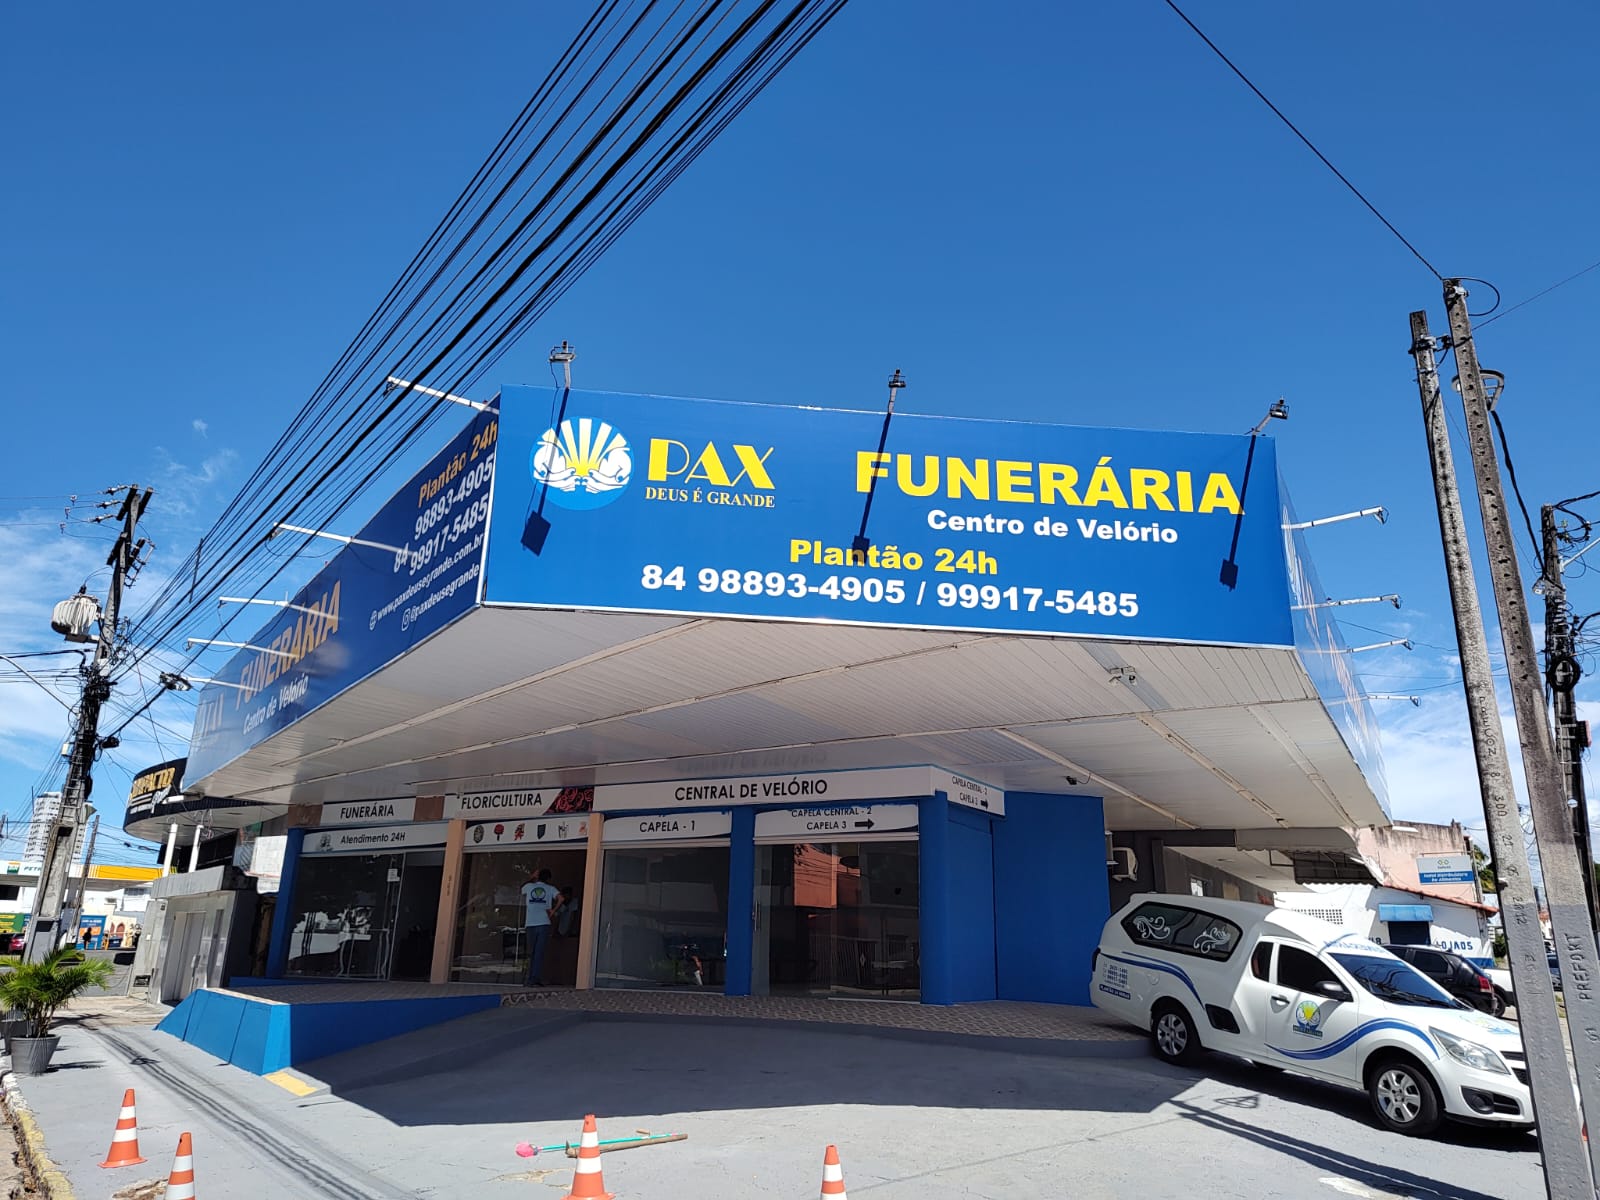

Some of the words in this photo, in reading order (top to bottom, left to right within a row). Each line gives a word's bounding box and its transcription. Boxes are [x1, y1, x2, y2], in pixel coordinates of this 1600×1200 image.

[418, 451, 467, 509] Plantão
[470, 420, 498, 461] 24h
[648, 438, 776, 490] PAX
[414, 452, 495, 541] 98893-4905
[645, 486, 689, 503] DEUS
[692, 487, 703, 503] É
[707, 493, 776, 508] GRANDE
[855, 450, 1245, 516] FUNERÁRIA
[393, 542, 409, 573] 84
[409, 492, 489, 576] 99917-5485
[927, 510, 1025, 536] Centro
[1033, 515, 1069, 538] de
[1076, 519, 1178, 544] Velório
[789, 539, 924, 571] Plantão
[934, 547, 998, 575] 24h
[377, 532, 484, 620] www.paxdeusegrande.com.br
[410, 563, 480, 622] @paxdeusegrande
[641, 564, 686, 591] 84
[697, 567, 906, 605] 98893-4905
[916, 581, 926, 606] /
[936, 582, 1139, 618] 99917-5485
[235, 580, 341, 711] FUNERÁRIA
[279, 672, 309, 711] Velório
[461, 793, 542, 810] FLORICULTURA
[674, 784, 735, 801] CENTRAL
[740, 784, 758, 798] DE
[762, 776, 828, 797] VELÓRIO
[340, 802, 395, 819] FUNERÁRIA
[639, 821, 679, 833] CAPELA
[690, 820, 696, 831] 1
[791, 808, 823, 818] CAPELA
[824, 807, 859, 817] CENTRAL
[866, 807, 872, 815] 2
[806, 821, 839, 831] CAPELA
[841, 820, 847, 829] 3
[391, 832, 406, 842] 24H
